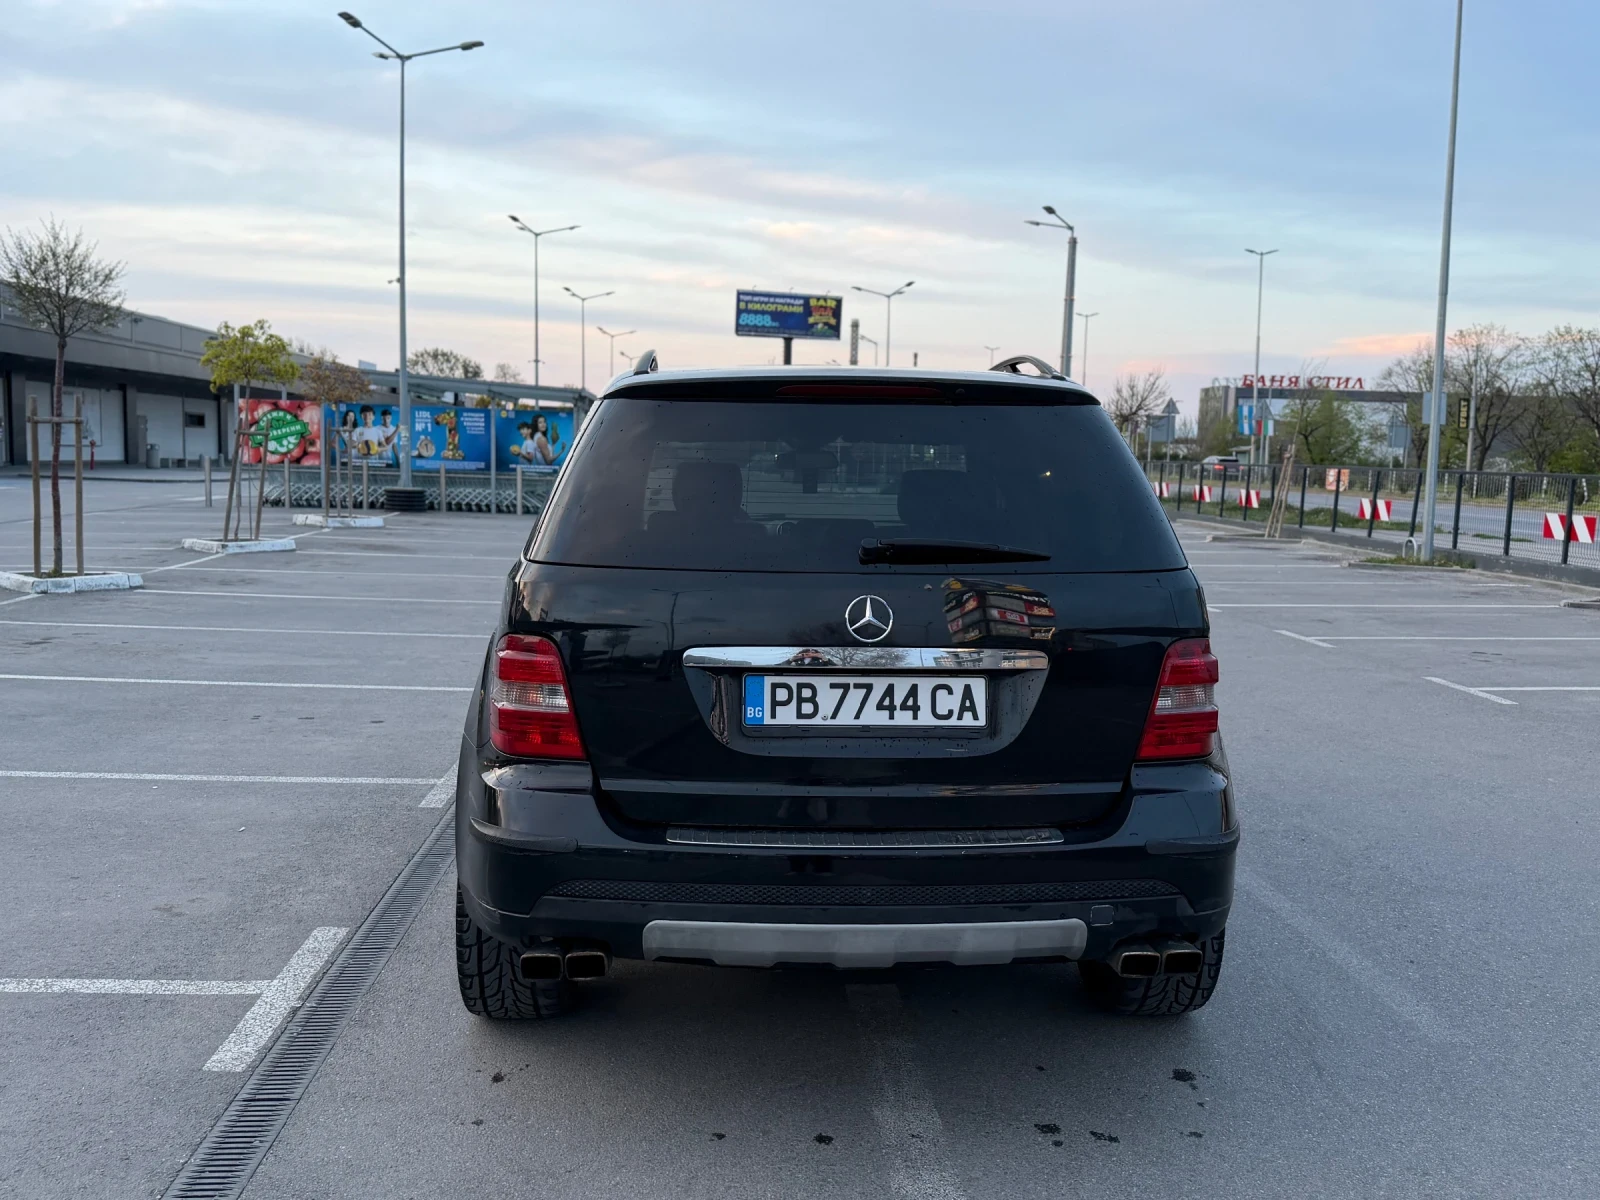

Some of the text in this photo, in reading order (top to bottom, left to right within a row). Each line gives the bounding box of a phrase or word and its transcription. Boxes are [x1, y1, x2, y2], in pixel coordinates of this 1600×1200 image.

[749, 303, 803, 313] КИЛОГРАМИ
[1242, 374, 1300, 388] БАНЯ
[1308, 375, 1365, 389] СТИЛ
[260, 411, 284, 425] СВЕЖИ
[257, 424, 301, 439] ОВЕРЕНИ
[770, 682, 979, 721] PB 7744 CA
[747, 706, 763, 718] BG
